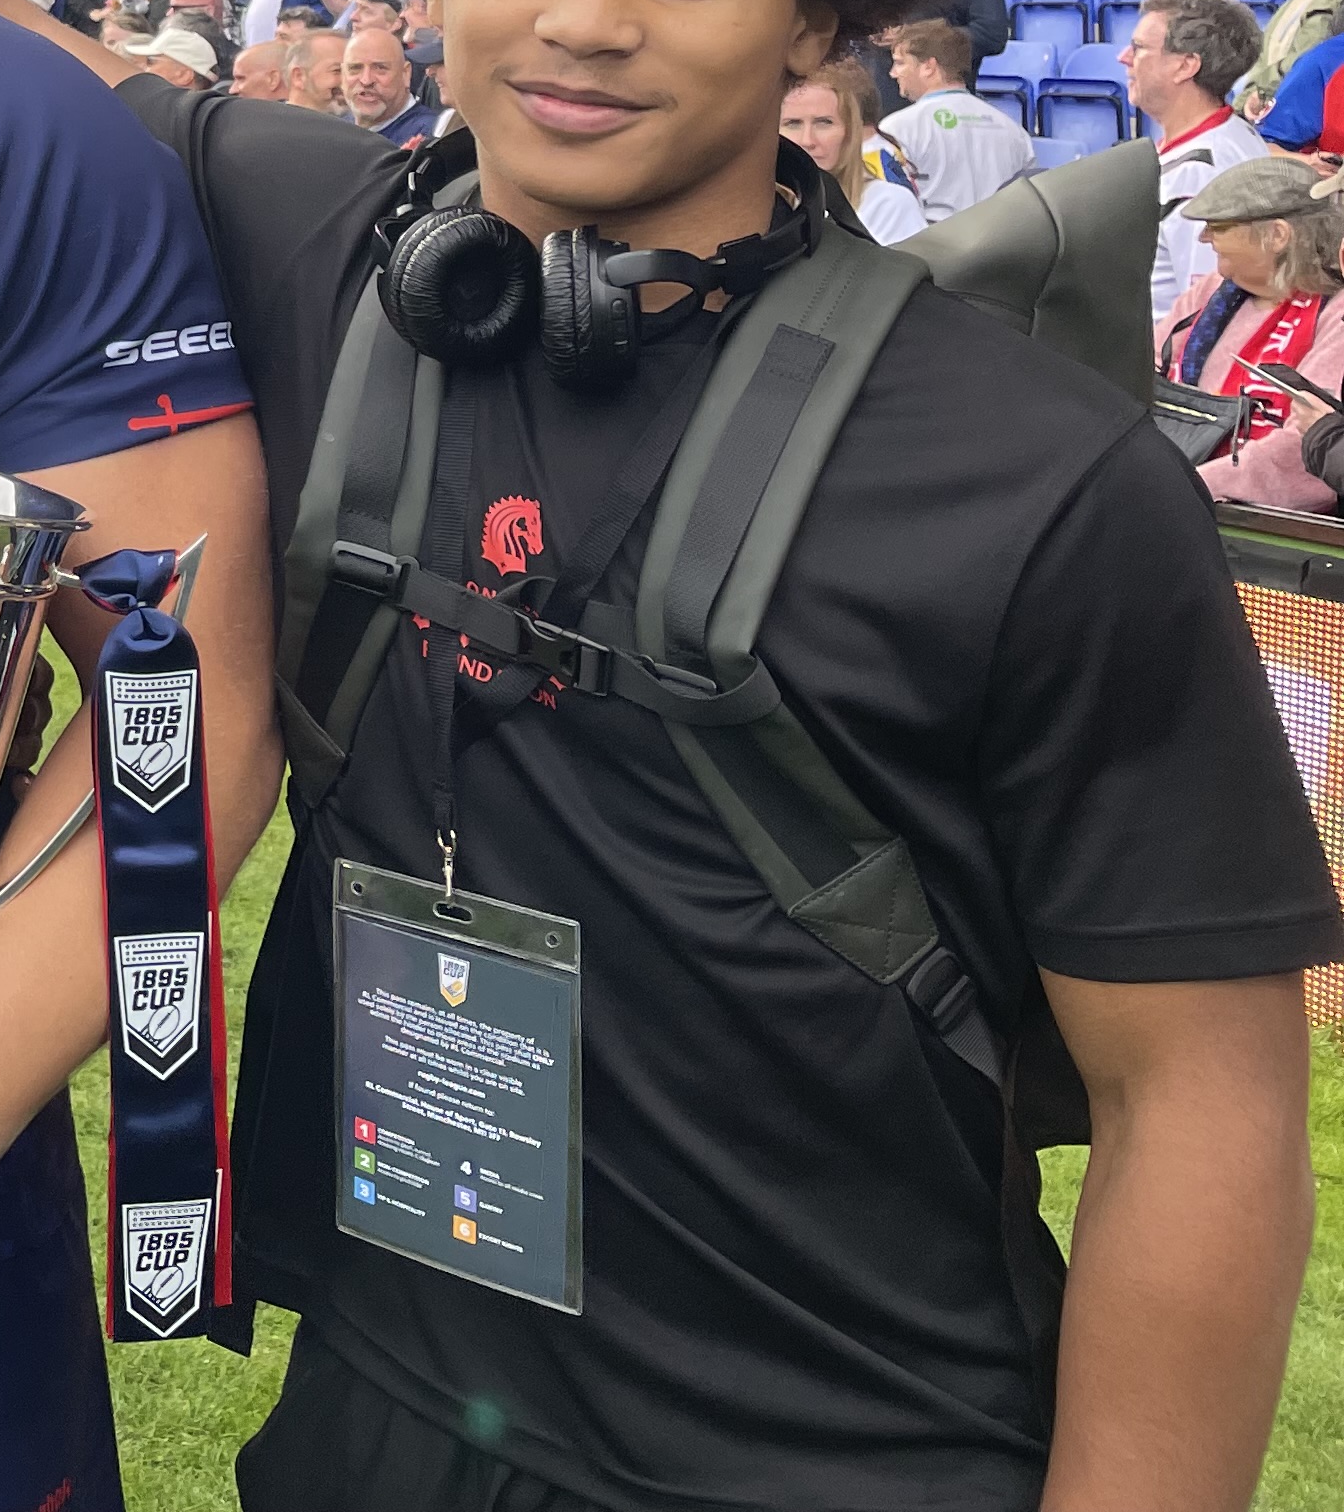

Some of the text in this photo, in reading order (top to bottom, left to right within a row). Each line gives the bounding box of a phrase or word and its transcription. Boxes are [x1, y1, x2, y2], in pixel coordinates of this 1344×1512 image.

[102, 321, 235, 369] SEEE
[123, 705, 183, 727] 1895
[122, 724, 179, 747] CUP
[132, 967, 189, 990] 1895
[443, 968, 464, 979] CUP
[131, 986, 185, 1012] CUP
[359, 1122, 368, 1138] 1
[359, 1153, 371, 1168] 2
[460, 1160, 473, 1176] 4
[359, 1182, 370, 1198] 3
[460, 1190, 471, 1207] 5
[459, 1221, 471, 1237] 6
[137, 1230, 193, 1253] 1895
[135, 1248, 190, 1272] CUP
